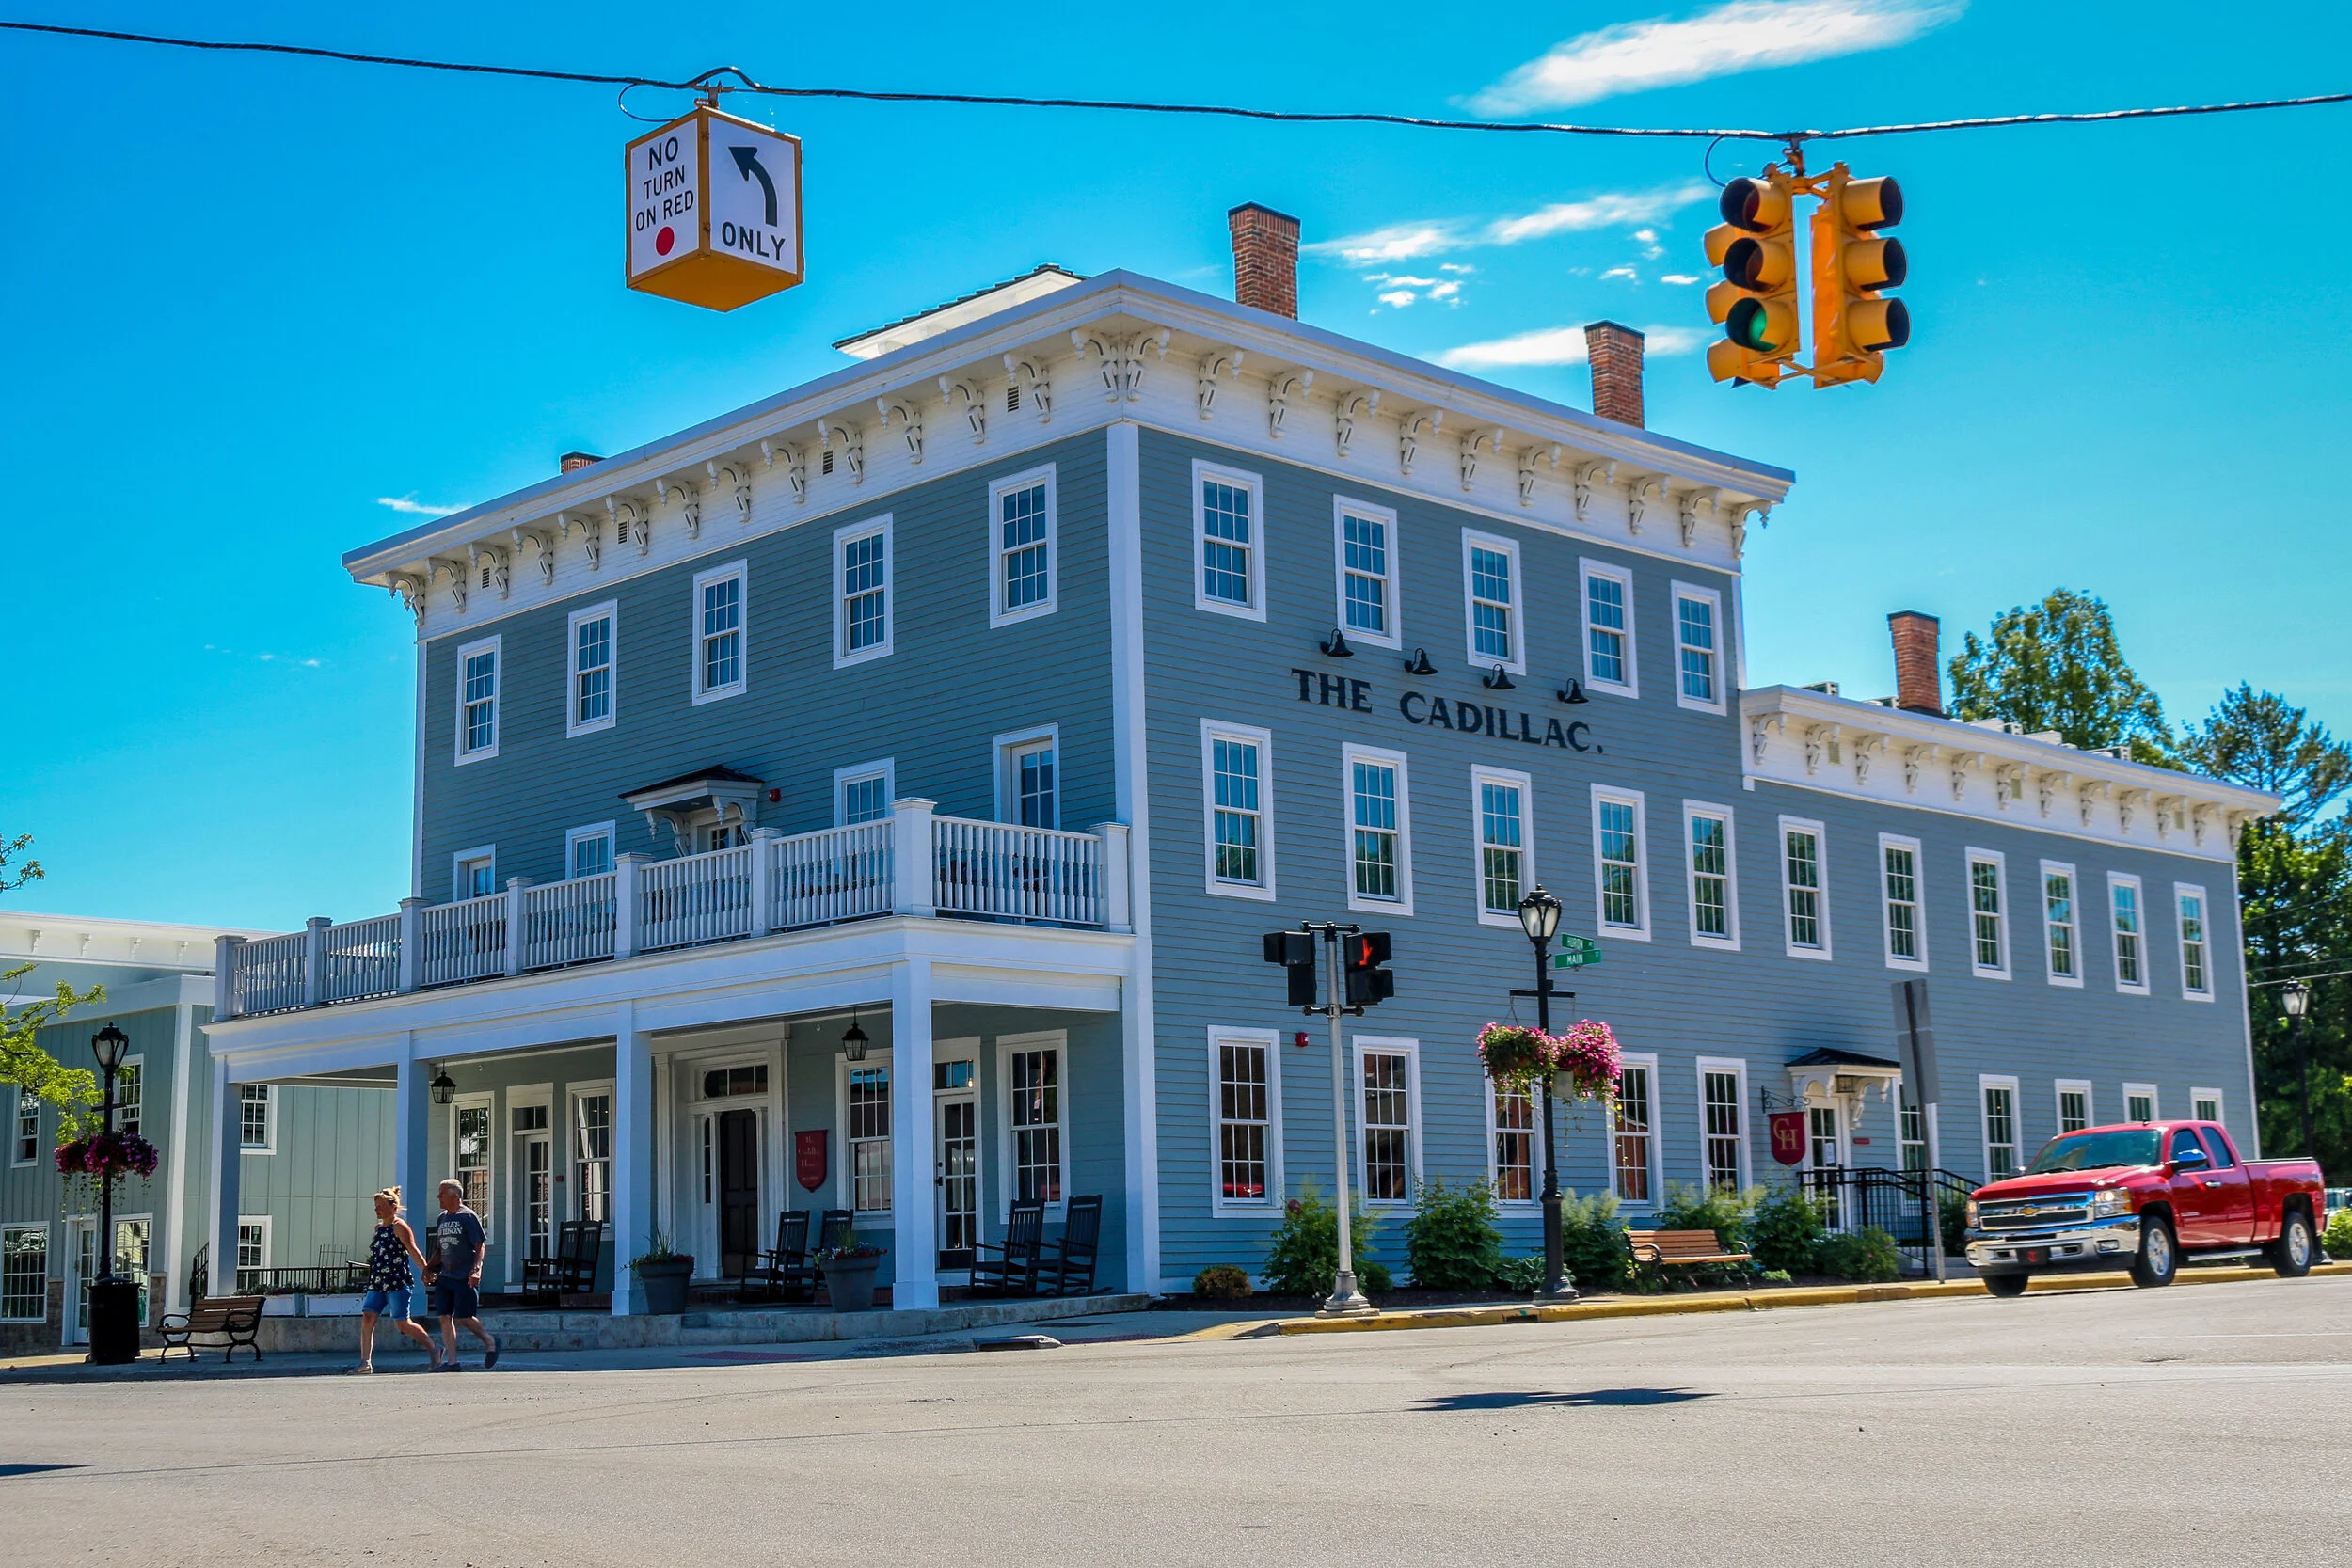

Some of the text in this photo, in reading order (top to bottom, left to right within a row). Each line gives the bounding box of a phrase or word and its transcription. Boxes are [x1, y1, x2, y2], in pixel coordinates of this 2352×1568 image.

[648, 136, 678, 171] NO
[644, 164, 685, 200] TURN
[635, 190, 694, 231] ON RED
[722, 221, 786, 261] ONLY
[1291, 667, 1373, 714] THE
[1566, 954, 1583, 966] MAIN
